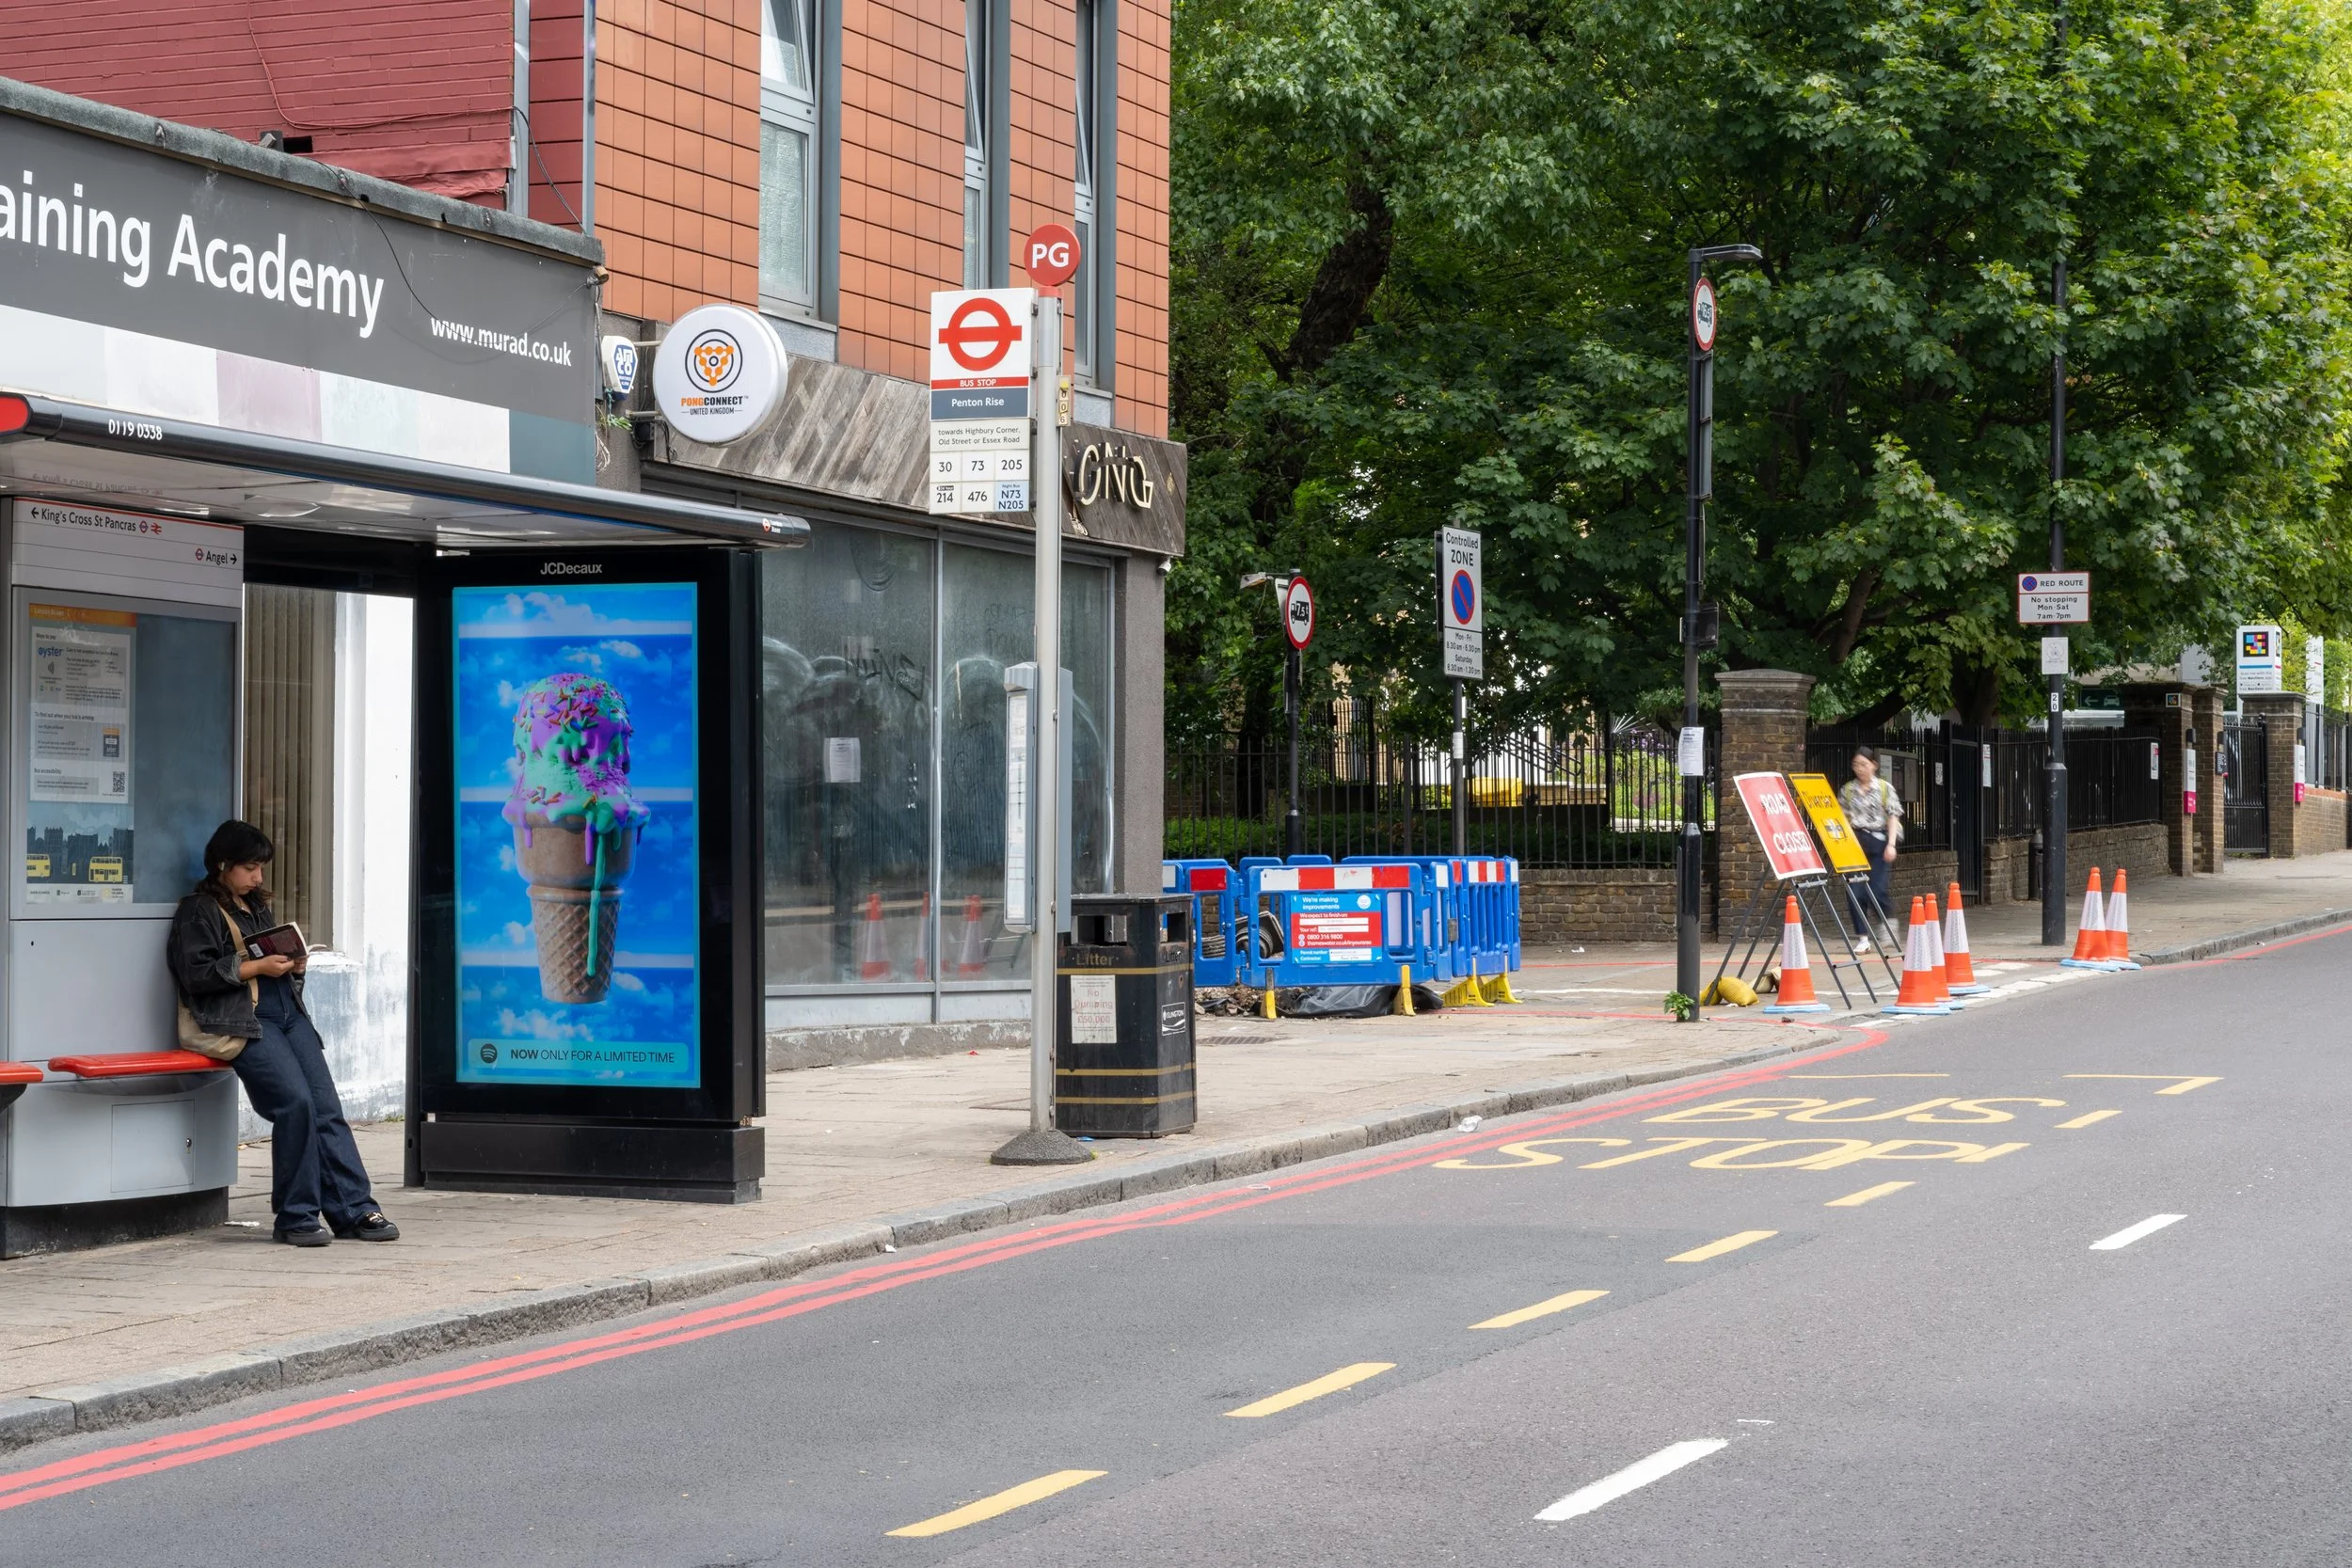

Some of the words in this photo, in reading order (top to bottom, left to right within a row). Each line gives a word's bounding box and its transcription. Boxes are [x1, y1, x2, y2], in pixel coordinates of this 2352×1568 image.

[0, 170, 151, 288] aining
[167, 214, 384, 339] Academy
[1031, 242, 1070, 268] PG
[430, 317, 572, 367] www.murad.co.uk
[960, 379, 974, 388] BUS
[977, 378, 996, 387] STOP
[681, 396, 743, 406] PONGCONNECT
[951, 398, 983, 407] Penton
[985, 397, 1005, 406] Rise
[109, 419, 135, 436] 0119
[137, 423, 163, 440] 0338
[965, 427, 993, 436] Highbury
[939, 461, 952, 472] 30
[971, 461, 985, 471] 73
[1001, 459, 1023, 470] 205
[936, 492, 954, 503] 214
[967, 491, 988, 502] 476
[1001, 489, 1022, 499] N73
[997, 500, 1024, 510] N205
[41, 508, 67, 525] King's
[69, 512, 92, 526] Cross
[94, 515, 103, 527] St
[105, 516, 136, 531] Pancras
[1446, 532, 1479, 549] Controlled
[205, 550, 229, 565] Angel
[1451, 549, 1474, 566] ZONE
[540, 562, 603, 576] JCDecaux
[1759, 793, 1791, 815] ROAD
[1772, 831, 1812, 854] CLOSED
[1076, 952, 1114, 967] Litter
[510, 1050, 538, 1059] NOW
[540, 1050, 569, 1060] ONLY
[571, 1051, 593, 1061] FOR
[594, 1051, 602, 1061] A
[604, 1051, 646, 1062] LIMITED
[648, 1052, 675, 1063] TIME
[1641, 1097, 2069, 1125] BUS
[1434, 1137, 1988, 1170] STOP
